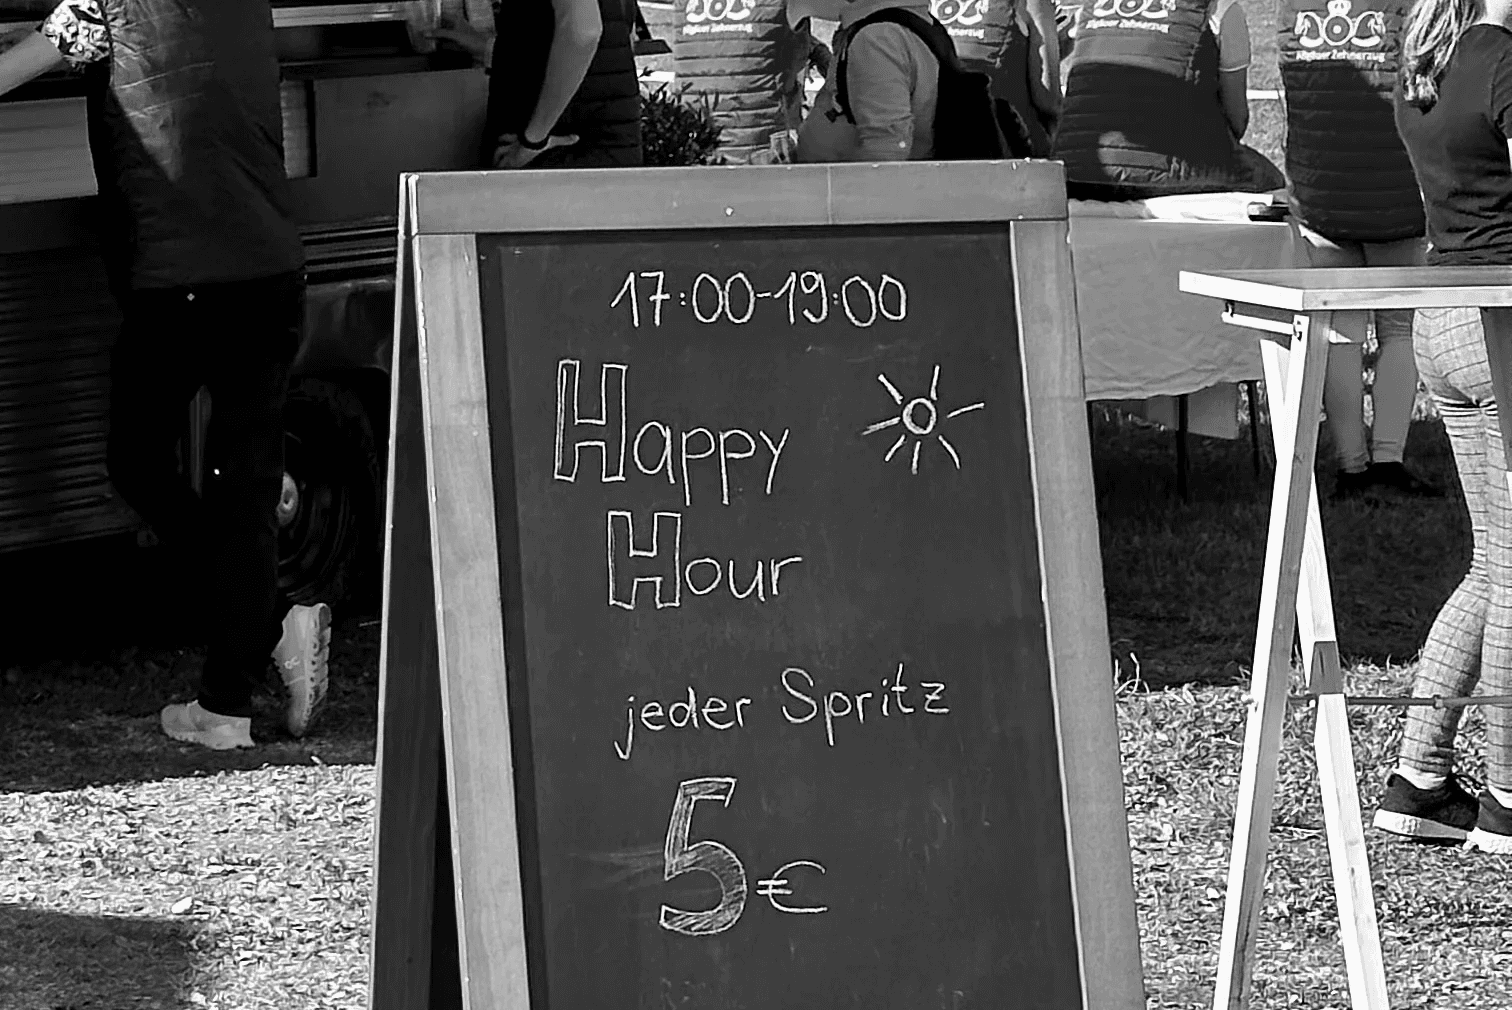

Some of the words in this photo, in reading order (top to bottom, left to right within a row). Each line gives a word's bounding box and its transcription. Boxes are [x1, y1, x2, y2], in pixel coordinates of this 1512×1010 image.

[610, 270, 908, 328] 17:00-19:00
[553, 358, 791, 506] Happy
[606, 510, 804, 609] Hour
[613, 686, 752, 761] jeder
[781, 662, 951, 747] Spritz
